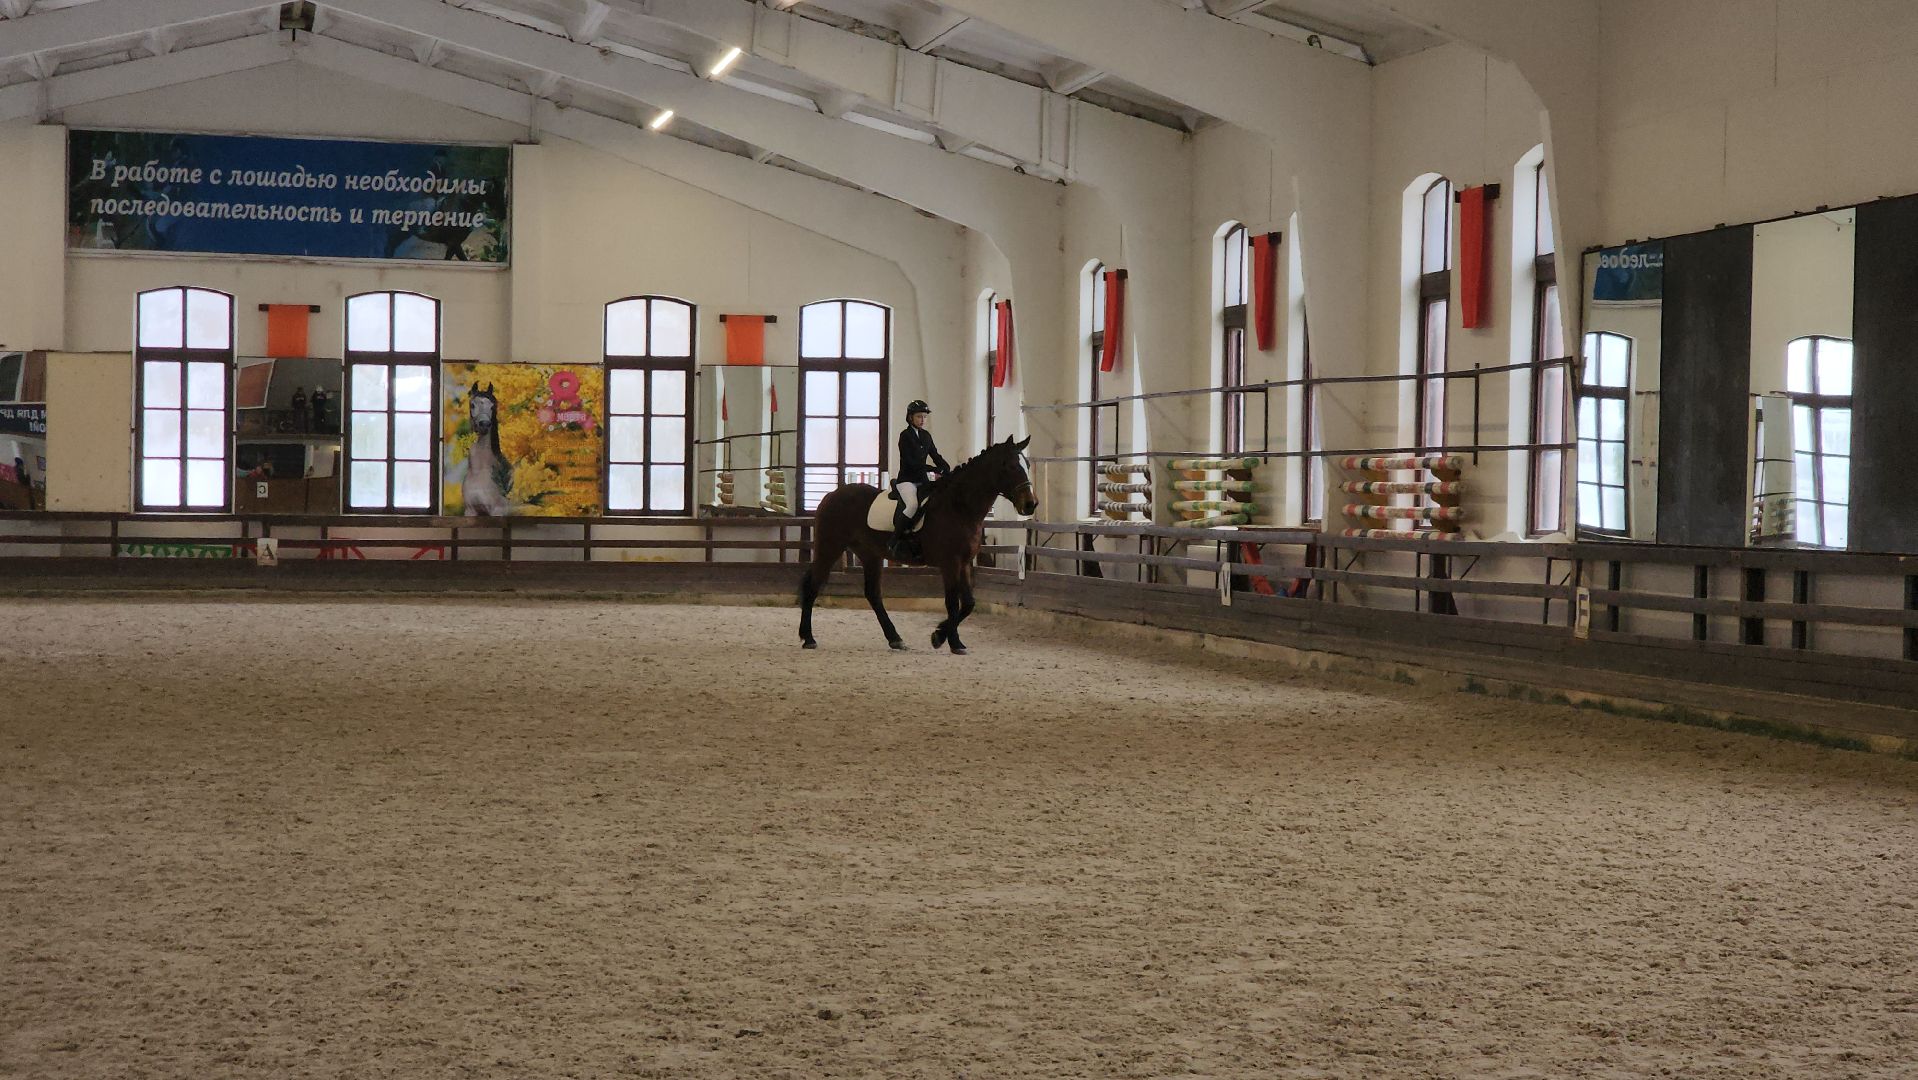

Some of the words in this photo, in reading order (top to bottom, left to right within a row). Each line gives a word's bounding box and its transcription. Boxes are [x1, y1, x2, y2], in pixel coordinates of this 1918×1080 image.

[90, 159, 106, 180] В
[111, 160, 202, 188] работе
[209, 168, 222, 185] с
[227, 164, 338, 189] лошадью
[344, 168, 486, 195] необходимы
[90, 193, 342, 223] последовательность
[349, 207, 364, 224] и
[371, 208, 485, 232] терпение
